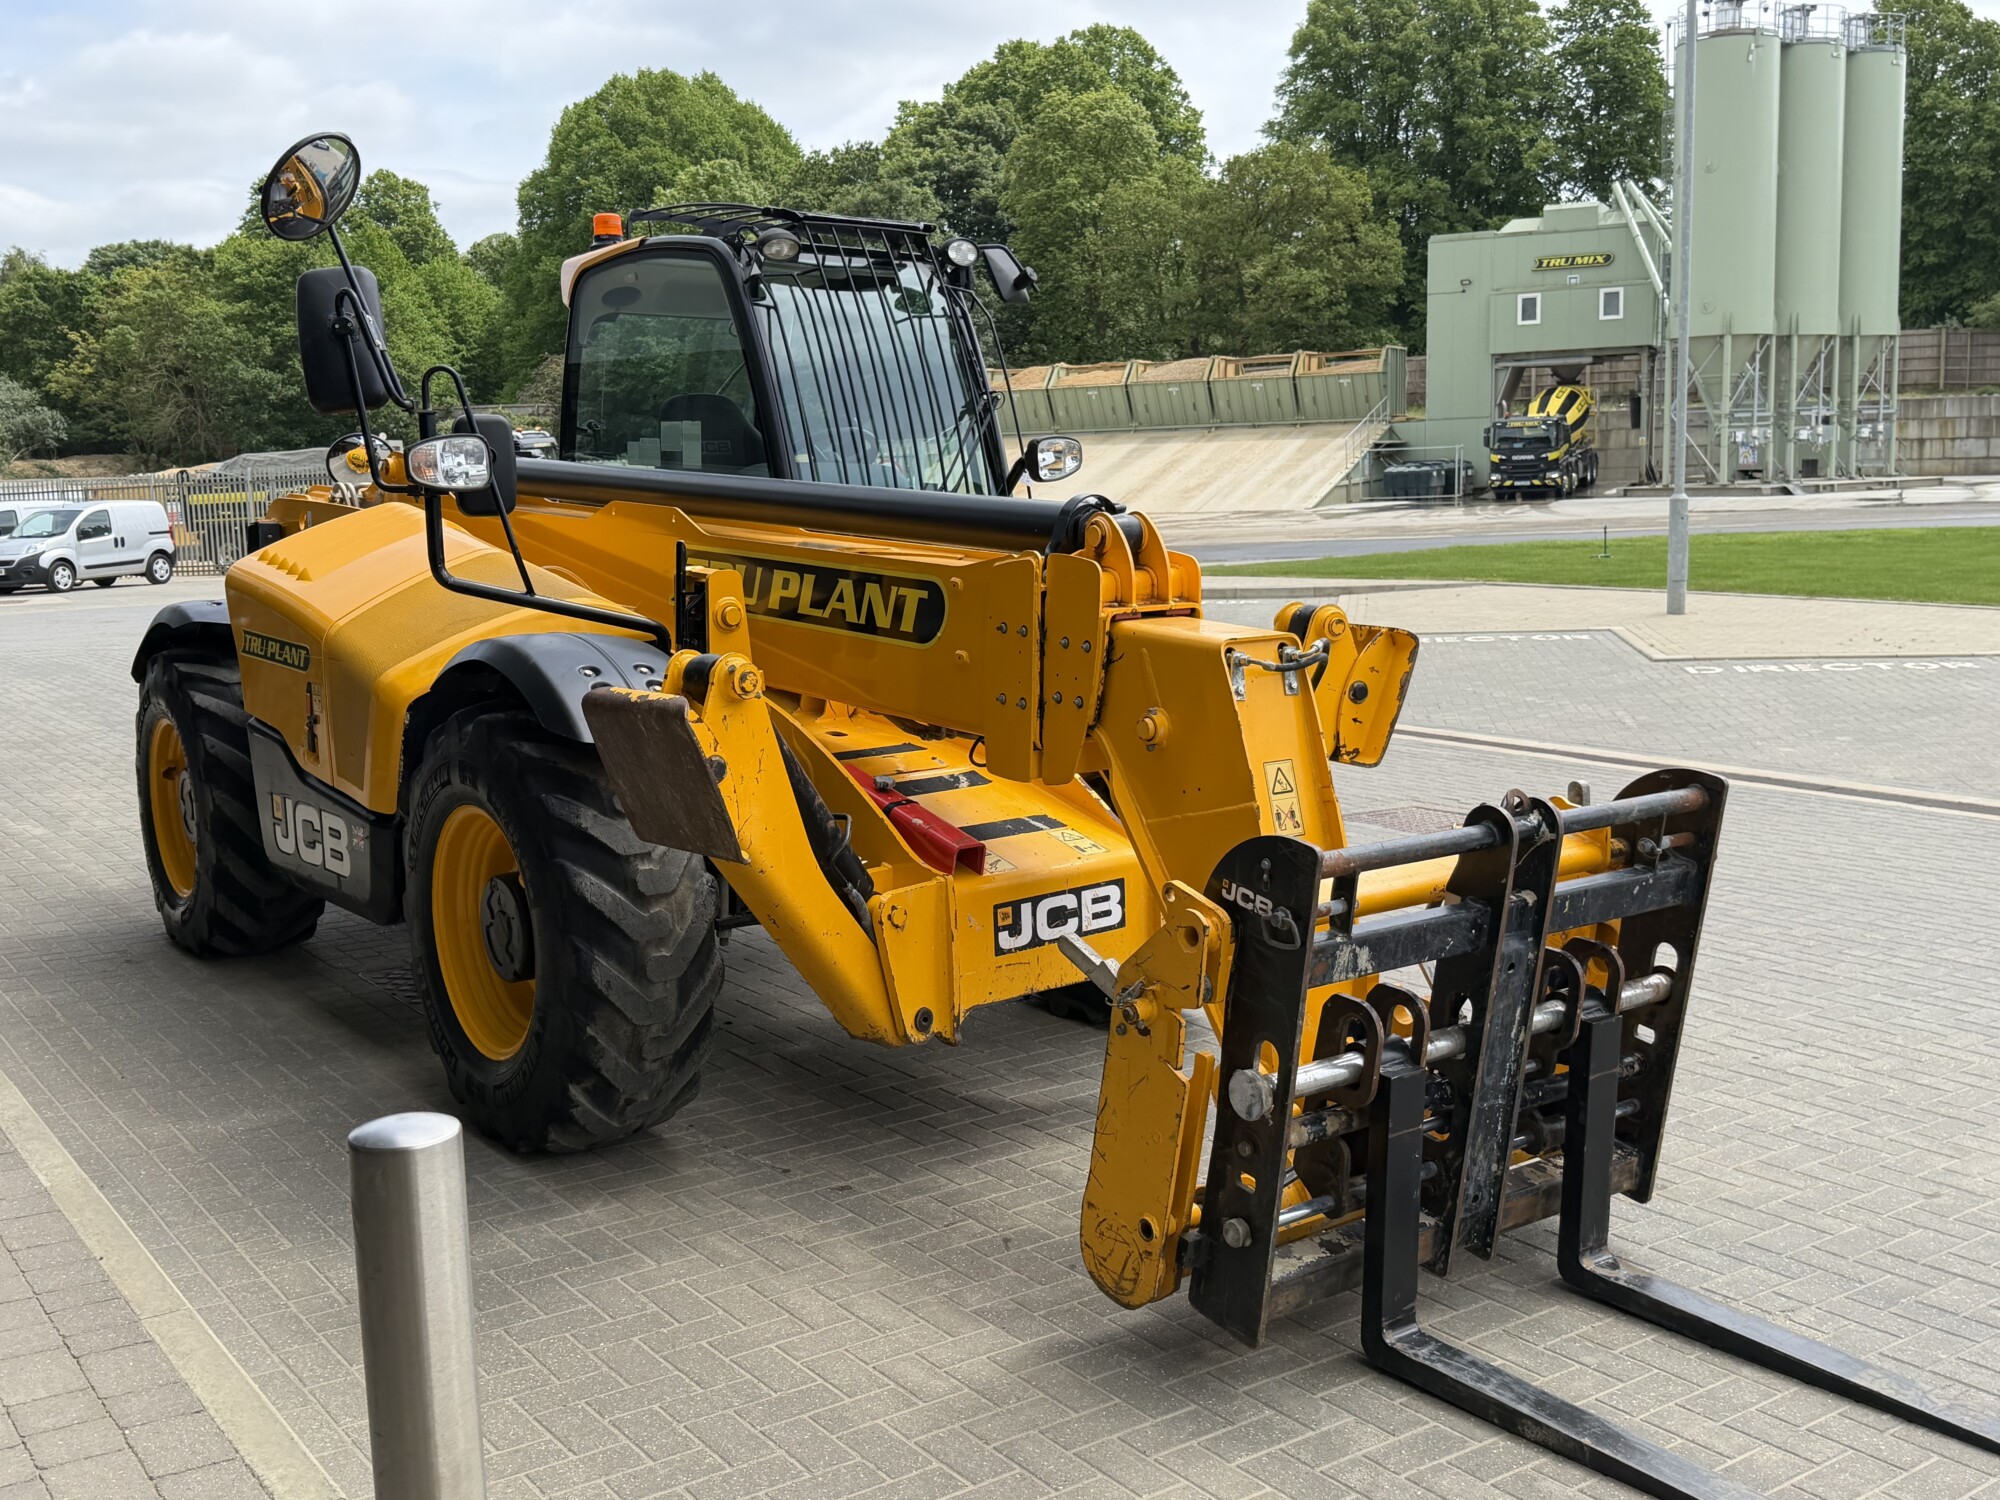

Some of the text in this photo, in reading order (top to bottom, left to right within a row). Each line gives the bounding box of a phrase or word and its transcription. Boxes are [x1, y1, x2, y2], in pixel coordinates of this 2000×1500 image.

[1541, 255, 1606, 267] TRU MIX
[704, 442, 730, 453] CB
[768, 569, 929, 633] PLANT
[245, 634, 307, 668] TRU PLANT
[1684, 662, 1981, 674] DIRECTOR
[274, 796, 351, 877] JCB
[1222, 882, 1273, 916] JCB
[997, 884, 1123, 950] JCB
